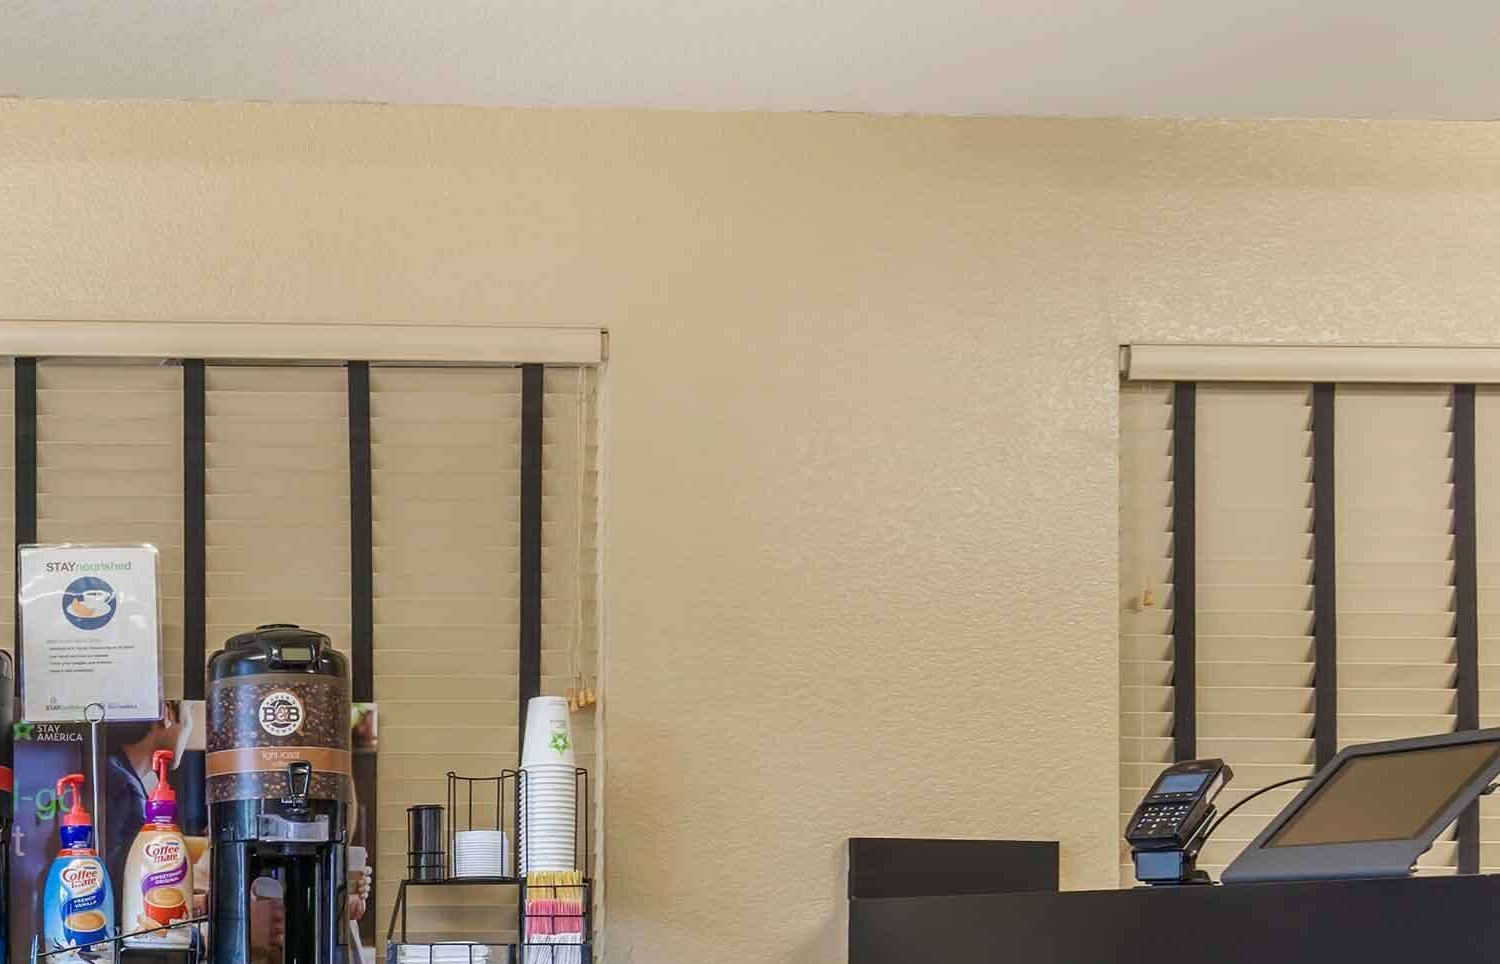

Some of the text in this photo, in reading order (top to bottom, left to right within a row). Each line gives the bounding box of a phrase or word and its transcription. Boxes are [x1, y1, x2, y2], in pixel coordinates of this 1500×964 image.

[37, 724, 61, 733] STAY
[37, 733, 84, 742] AMERICA
[145, 845, 180, 858] Coffee
[154, 854, 178, 864] mate
[62, 868, 99, 883] Coffee
